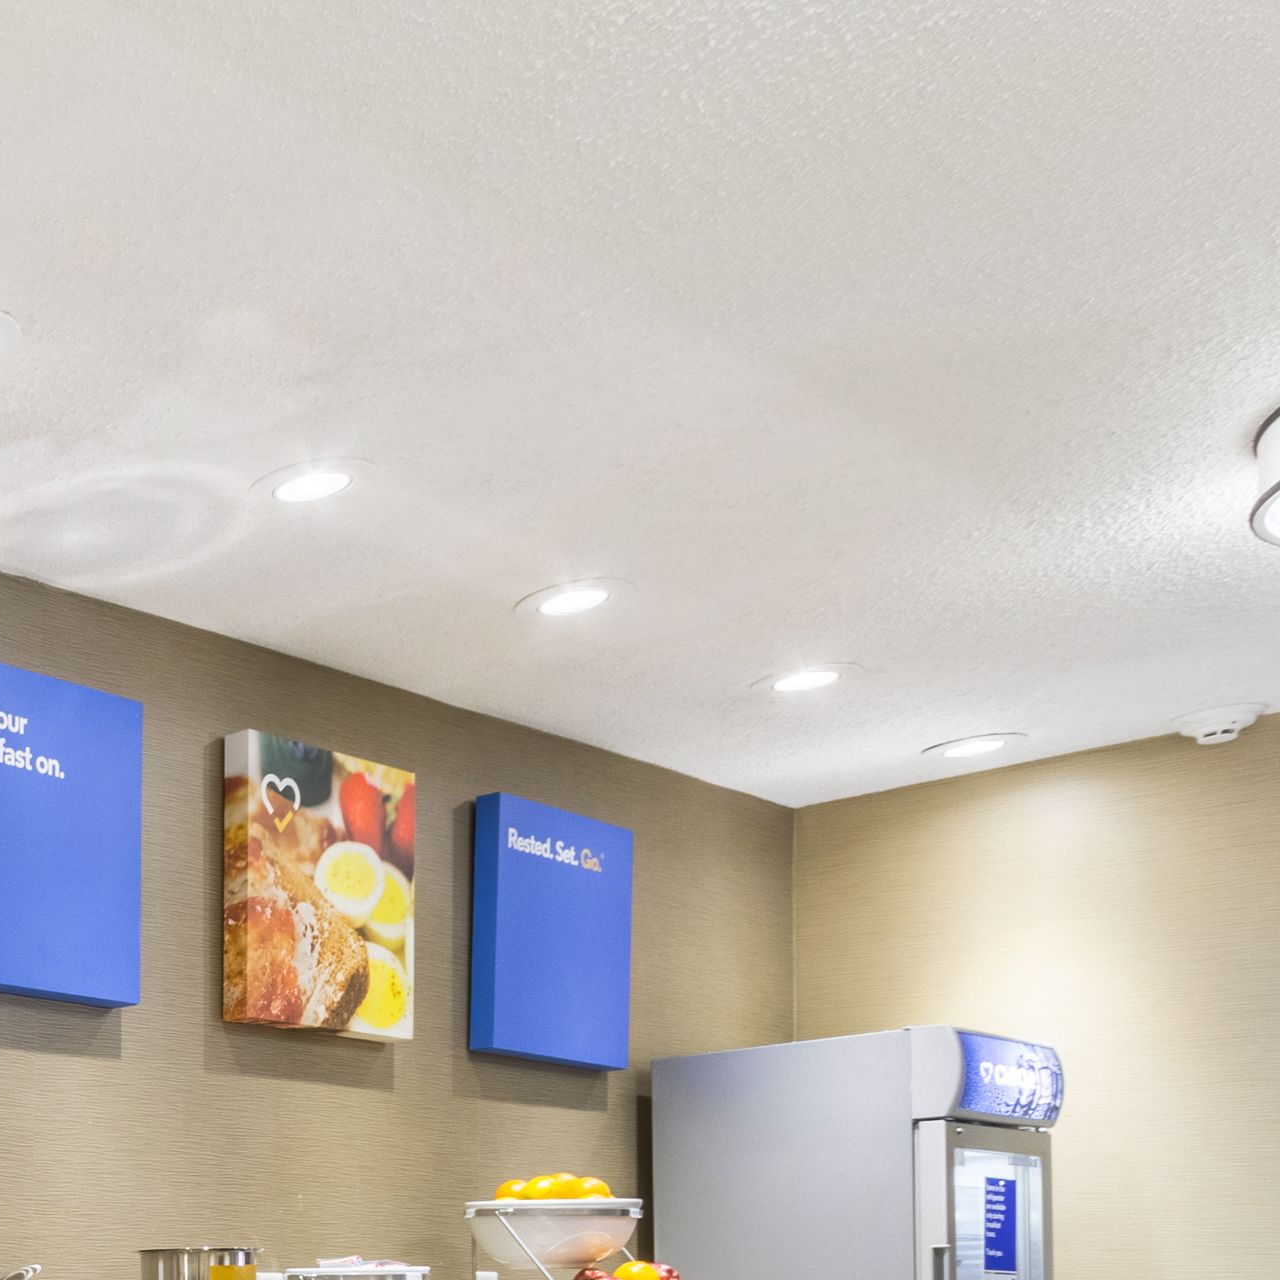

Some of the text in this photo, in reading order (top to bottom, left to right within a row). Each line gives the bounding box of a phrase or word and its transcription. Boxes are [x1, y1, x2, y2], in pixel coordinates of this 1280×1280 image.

[35, 755, 65, 779] on.
[507, 827, 554, 859] Rested.
[555, 840, 579, 867] Set.
